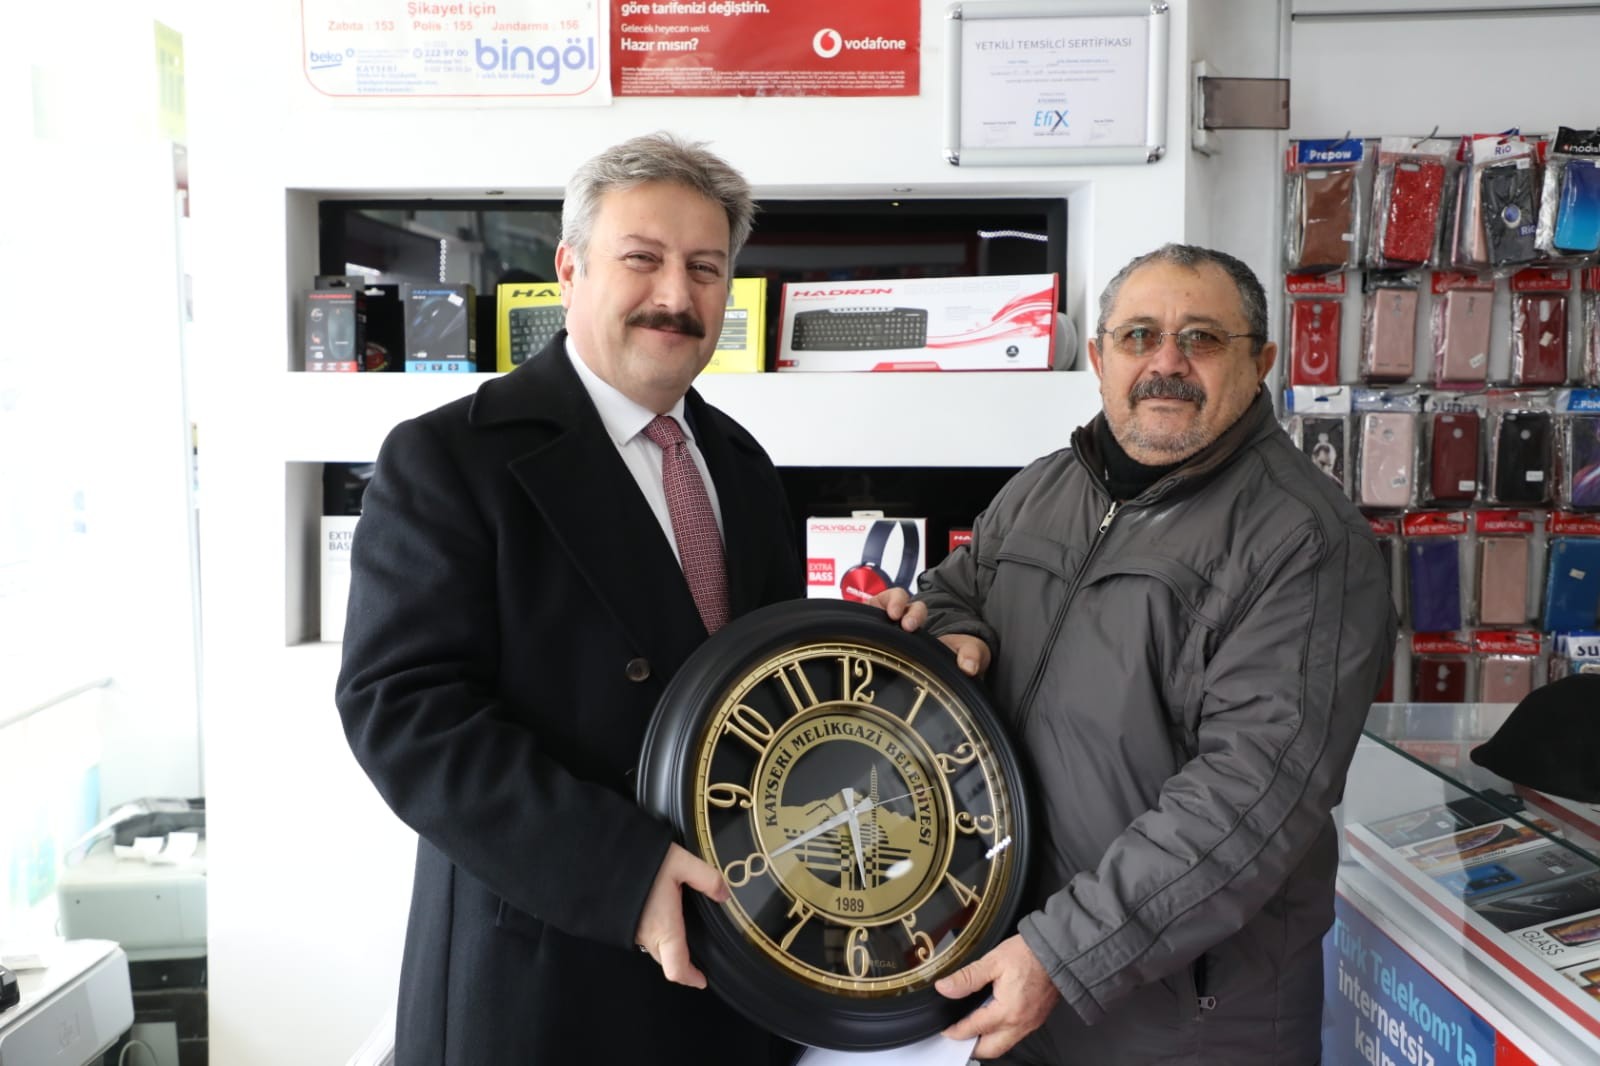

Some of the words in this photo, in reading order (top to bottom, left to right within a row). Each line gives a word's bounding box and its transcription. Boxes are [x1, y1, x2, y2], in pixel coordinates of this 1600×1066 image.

[407, 2, 465, 17] Şikayet
[468, 2, 496, 17] için
[621, 2, 650, 17] göre
[652, 0, 707, 14] tarifenizi
[708, 0, 770, 16] değiştirin.
[328, 20, 364, 31] Zabıta
[374, 20, 395, 31] 153
[413, 20, 442, 31] Polis
[452, 20, 473, 31] 155
[491, 20, 549, 31] Jandarma
[560, 20, 579, 30] 156
[621, 23, 654, 33] Gelecek
[655, 23, 689, 34] heyecan
[621, 38, 654, 50] Hazır
[657, 38, 699, 50] mısın?
[844, 37, 906, 50] vodafone
[975, 39, 1015, 51] YETKİLİ
[1016, 38, 1066, 50] TEMSİLCİ
[1067, 36, 1132, 48] SERTİFİKASI
[310, 50, 343, 63] beko
[474, 37, 595, 85] bingöl
[1308, 150, 1352, 161] Prepow
[511, 288, 562, 297] HA
[793, 288, 893, 297] HADRON
[329, 531, 352, 541] EXT
[810, 524, 866, 532] POLYGOLD
[810, 564, 832, 572] EXTRA
[809, 572, 833, 582] BASS
[773, 660, 820, 714] 11
[838, 655, 875, 704] 12
[905, 681, 931, 726] 1
[721, 702, 775, 754] 10
[935, 740, 978, 774] 2
[765, 745, 794, 828] KAYSERİ
[791, 719, 885, 751] MELİKGAZİ
[885, 741, 933, 850] BELEDİYESİ
[707, 782, 755, 809] 9
[955, 811, 996, 835] 3
[724, 852, 768, 888] 8
[945, 871, 982, 907] 4
[835, 897, 865, 913] 1989
[780, 899, 816, 952] 7
[901, 913, 935, 962] 5
[1522, 930, 1565, 956] GLASS
[846, 926, 869, 978] 6
[1334, 917, 1368, 974] Türk
[1369, 949, 1477, 1066] Telekom'la
[1338, 960, 1435, 1066] internetsiz
